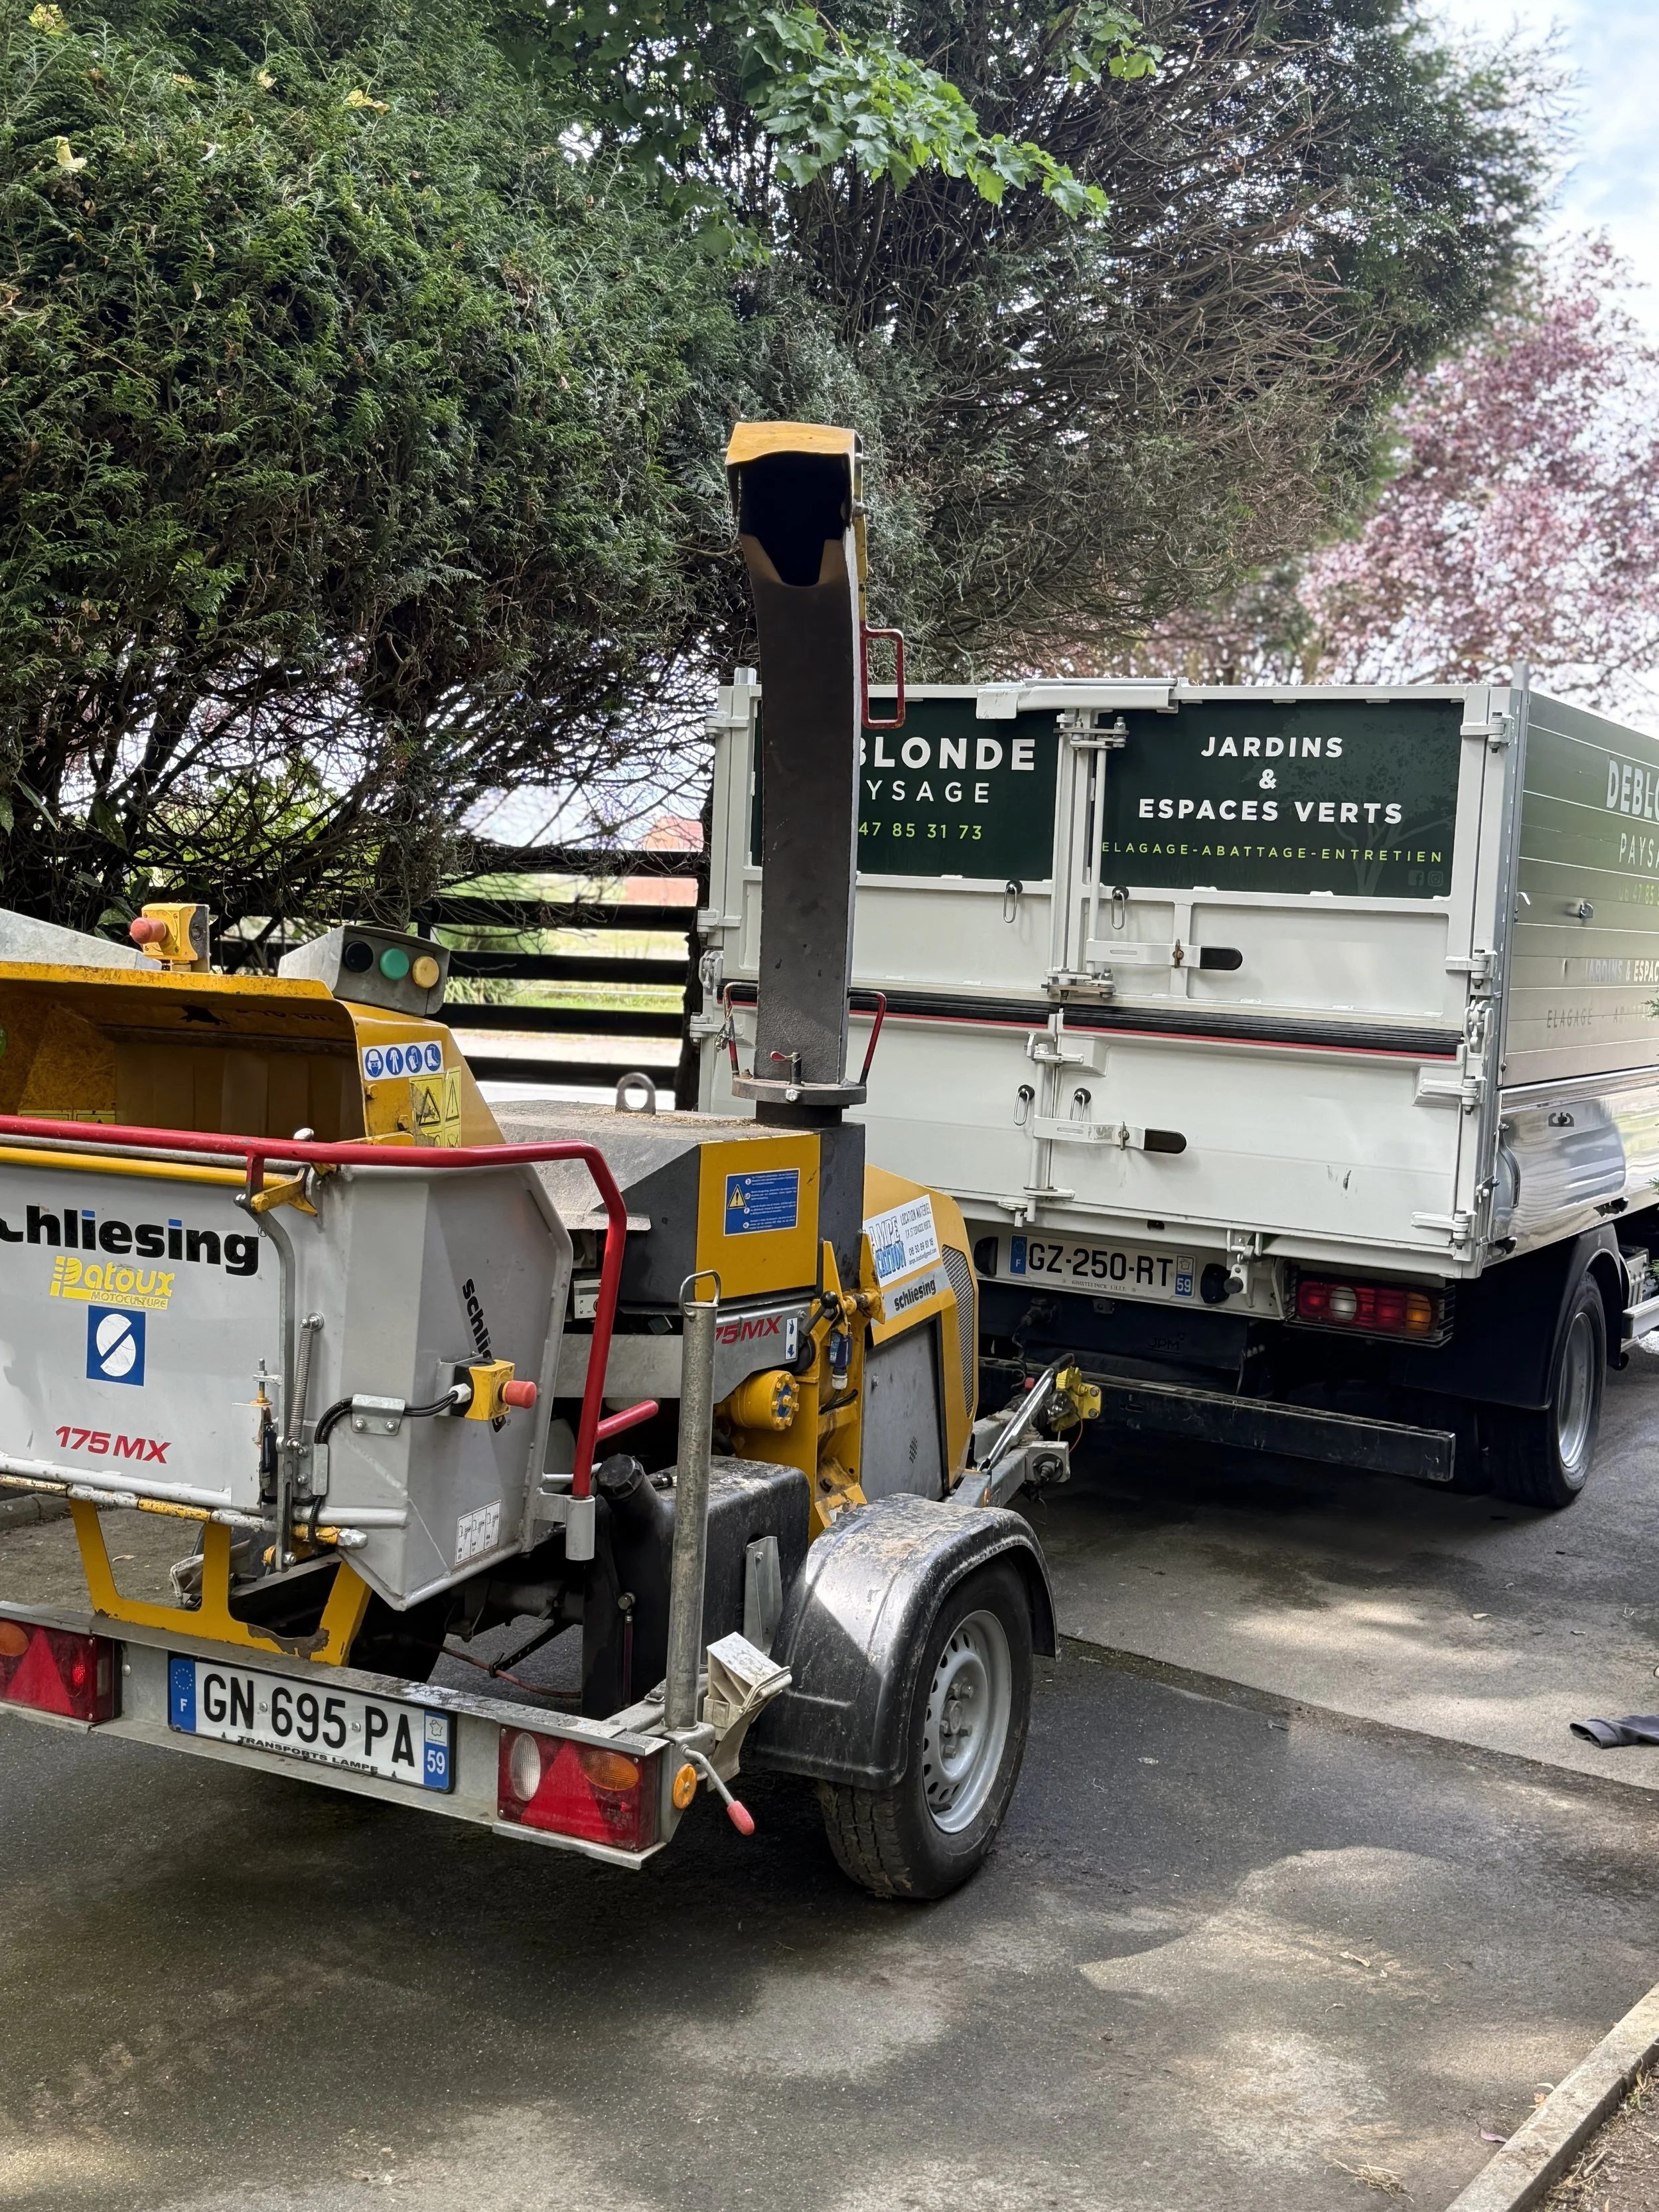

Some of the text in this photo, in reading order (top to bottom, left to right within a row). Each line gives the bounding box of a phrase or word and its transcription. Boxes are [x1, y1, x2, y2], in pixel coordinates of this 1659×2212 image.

[859, 737, 1035, 771] LONDE
[1201, 737, 1343, 758] JARDINS
[866, 780, 990, 803] YSAGE
[1259, 769, 1277, 789] &
[1139, 798, 1402, 824] ESPACES VERTS
[859, 822, 981, 840] 47 85 31 73
[1015, 1242, 1191, 1292] F GZ-250-RT 59
[894, 1279, 936, 1311] schliesing
[180, 1673, 446, 1775] F GN 695 PA 59
[238, 1735, 379, 1775] TRANSPORTS LAMPE
